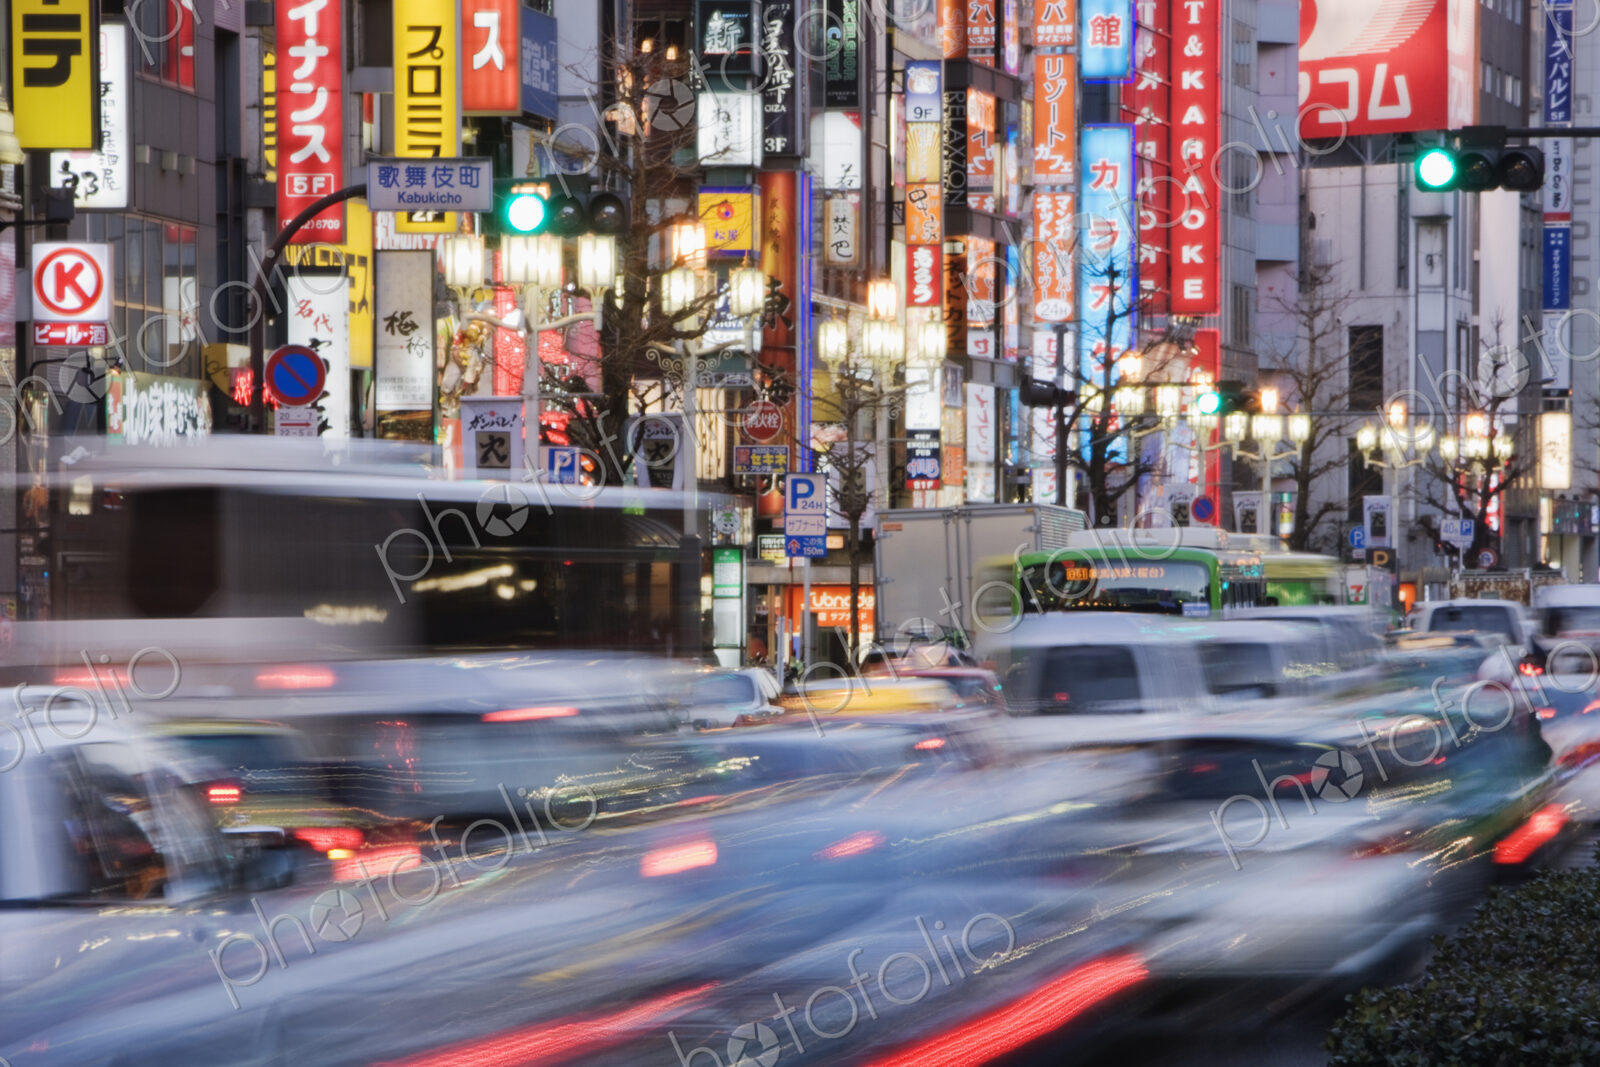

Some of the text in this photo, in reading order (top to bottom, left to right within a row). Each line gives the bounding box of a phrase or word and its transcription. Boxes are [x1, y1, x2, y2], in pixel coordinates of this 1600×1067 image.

[1041, 2, 1066, 22] パ
[1089, 15, 1121, 47] 館
[473, 12, 503, 71] ス
[288, 0, 331, 164] イナンス
[764, 104, 787, 113] GIZA
[1042, 57, 1067, 148] リゾート
[913, 106, 933, 119] 9F
[1551, 111, 1566, 121] 5F
[714, 107, 731, 155] ねぎし
[764, 137, 787, 153] 3F
[949, 91, 966, 205] RELAXZON
[1035, 143, 1073, 173] カフェ
[1552, 157, 1562, 173] Do
[292, 176, 326, 193] 5F
[377, 165, 481, 189] 歌舞伎町
[1552, 174, 1562, 189] Co
[397, 191, 462, 204] Kabukicho
[1552, 192, 1562, 208] Mo
[282, 220, 341, 230] (52)6709
[1036, 194, 1053, 242] ネット
[1055, 194, 1072, 241] マンガ
[714, 230, 738, 241] 松屋
[1040, 303, 1068, 316] 24H
[35, 326, 107, 344] ビール・酒
[747, 414, 779, 430] 消火栓
[907, 441, 940, 449] ENGLISH
[750, 453, 787, 466] セキネ
[915, 449, 932, 457] PUB
[554, 451, 572, 477] P
[906, 457, 940, 478] HUB
[913, 480, 934, 489] B1F
[791, 478, 815, 510] P
[801, 501, 822, 509] 24H
[788, 519, 824, 532] サブナード
[1462, 522, 1472, 536] P
[803, 538, 825, 546] この先
[1353, 531, 1366, 546] P
[803, 547, 825, 556] 150m
[1373, 551, 1389, 566] P
[830, 612, 867, 621] サブナド
